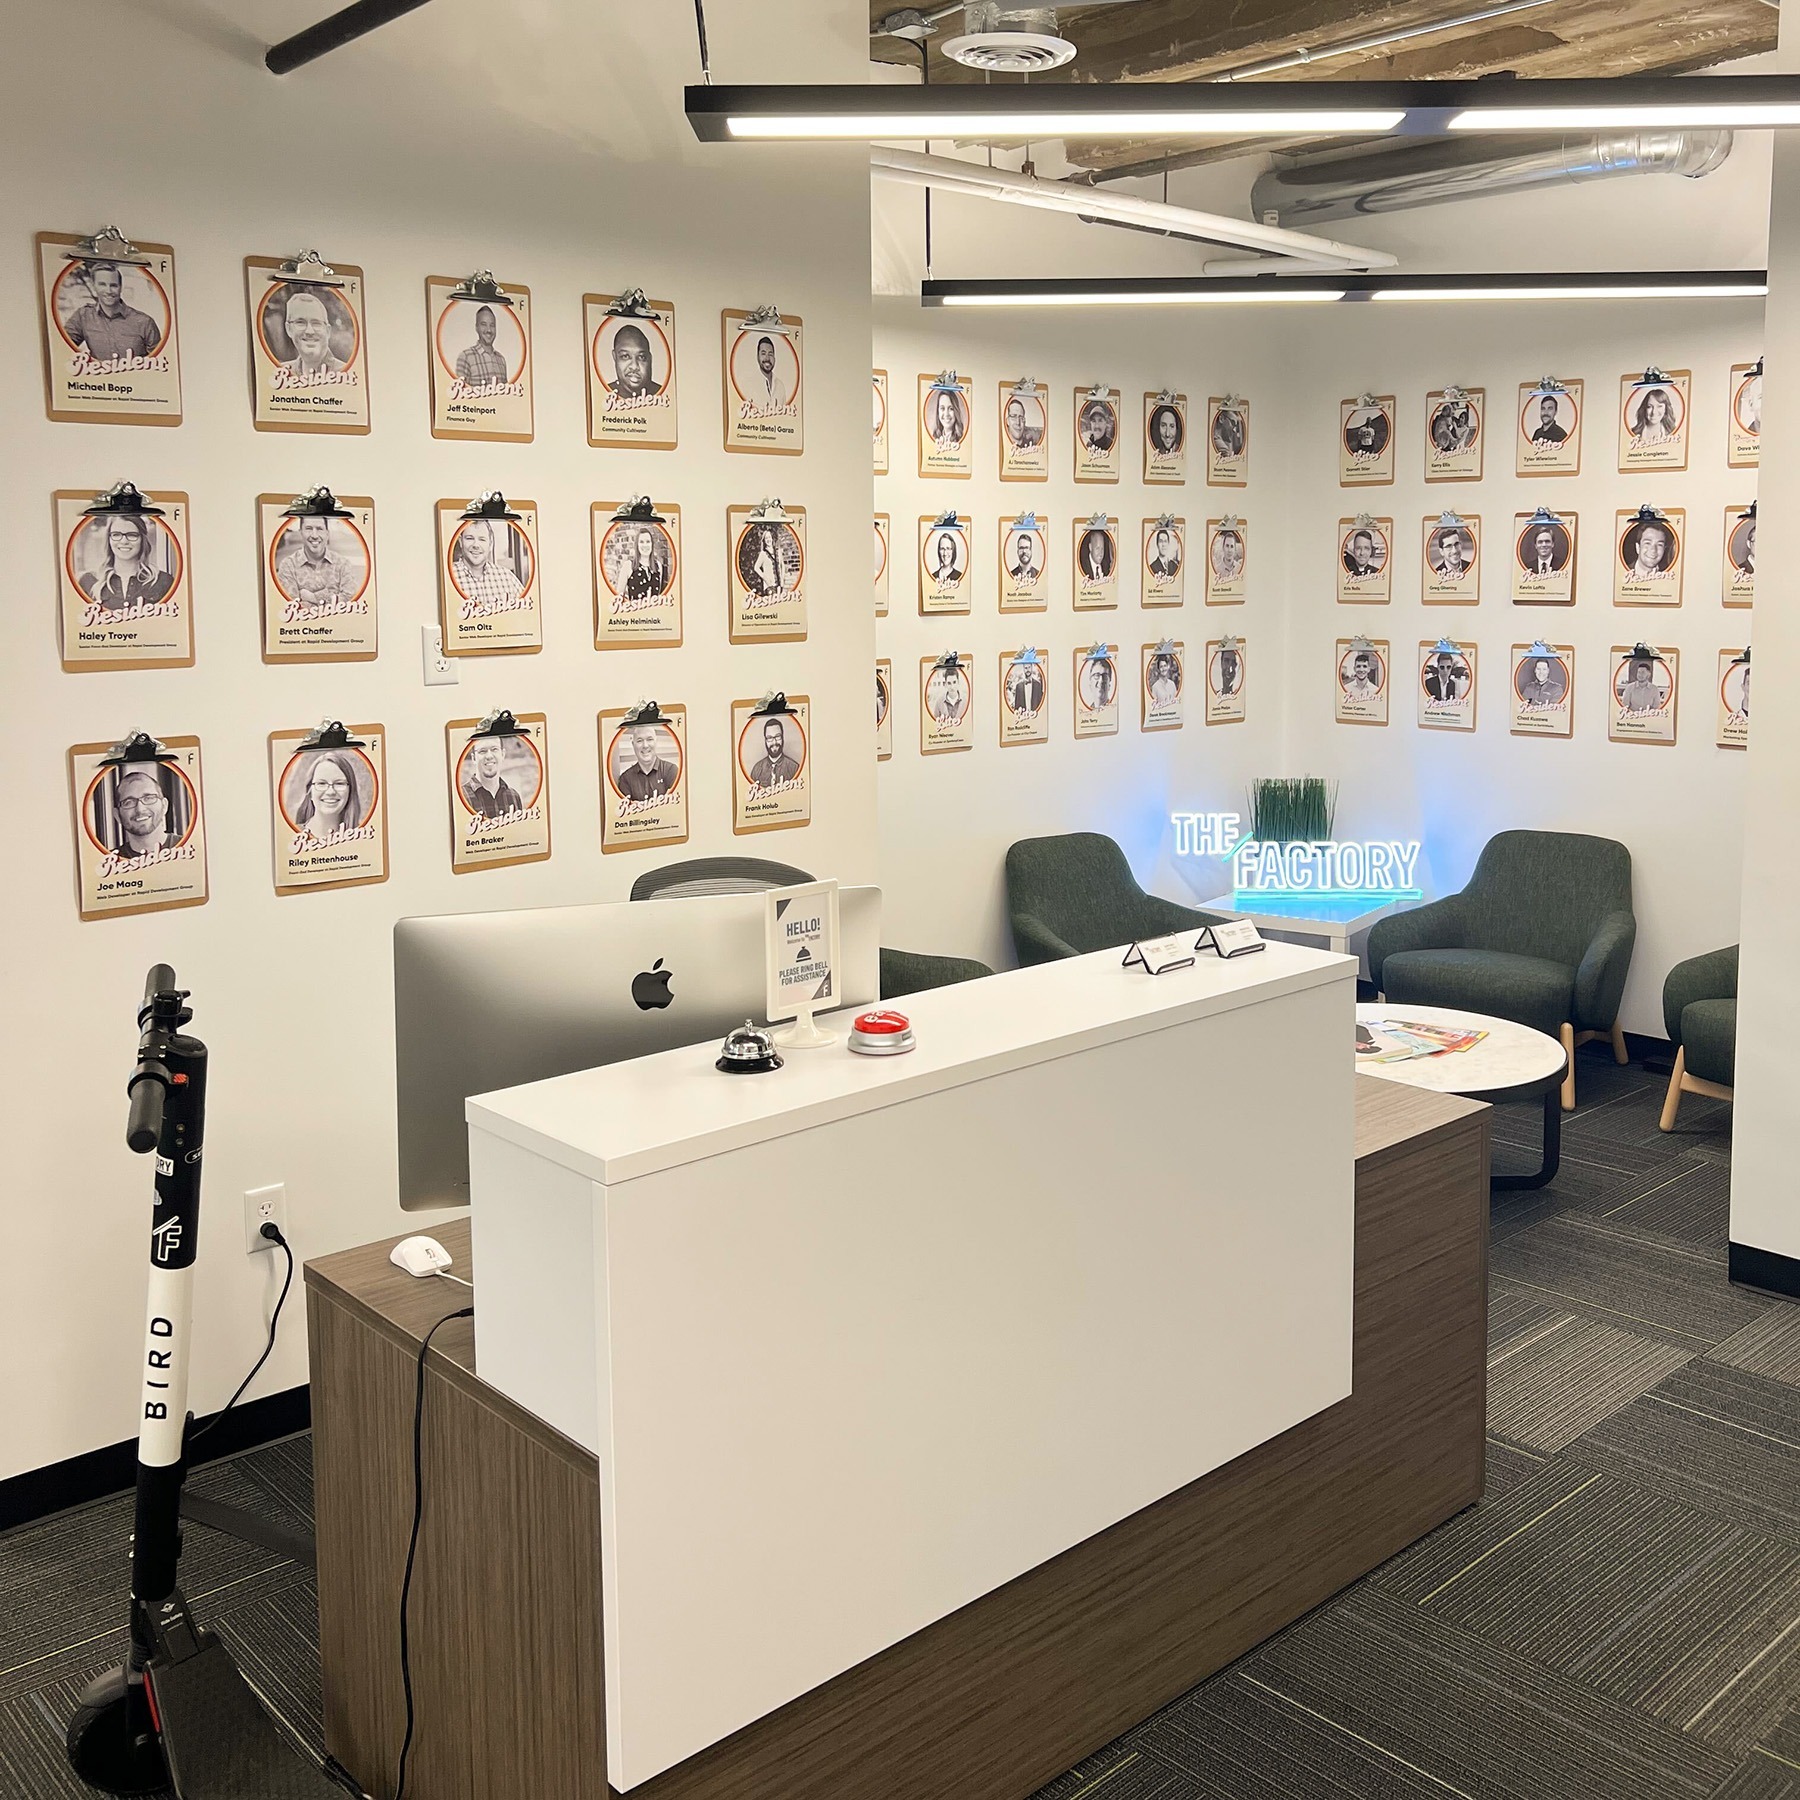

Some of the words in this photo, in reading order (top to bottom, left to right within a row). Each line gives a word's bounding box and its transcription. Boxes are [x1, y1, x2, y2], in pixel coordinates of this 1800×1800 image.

[69, 348, 169, 377] Resident
[270, 363, 358, 390] Resident
[67, 382, 106, 392] Michael
[107, 385, 133, 394] Bopp
[447, 376, 524, 400] Resident
[270, 395, 311, 405] Jonathan
[312, 396, 343, 405] Chaffer
[447, 404, 461, 412] Jeff
[462, 405, 496, 415] Steinport
[603, 388, 670, 412] Resident
[739, 399, 798, 420] Resident
[602, 416, 632, 425] Frederick
[633, 417, 648, 425] Polk
[737, 423, 759, 432] Alberto
[777, 426, 795, 434] Garza
[1629, 433, 1681, 450] Resident
[458, 592, 534, 620] Resident
[609, 588, 675, 614] Resident
[742, 585, 802, 610] Resident
[79, 596, 180, 627] Resident
[279, 594, 368, 623] Resident
[755, 612, 778, 620] Gilewski
[279, 627, 300, 635] Brett
[302, 627, 333, 635] Chaffer
[458, 625, 476, 633] Sam
[476, 623, 493, 632] Oltz
[608, 618, 629, 627] Ashley
[630, 617, 661, 625] Helminiak
[79, 632, 106, 641] Haley
[108, 632, 138, 641] Troyer
[747, 774, 804, 802] Resident
[616, 789, 681, 818] Resident
[745, 804, 760, 812] Frank
[762, 802, 779, 810] Holub
[465, 805, 541, 835] Resident
[614, 820, 628, 829] Dan
[629, 817, 661, 826] Billingsley
[288, 821, 376, 855] Resident
[466, 839, 480, 847] Ben
[481, 836, 504, 845] Braker
[1171, 812, 1241, 856] THE
[95, 841, 195, 878] Resident
[289, 859, 309, 868] Riley
[311, 854, 359, 864] Rittenhouse
[1233, 841, 1421, 890] FACTORY
[97, 883, 115, 892] Joe
[116, 880, 144, 889] Maag
[786, 917, 820, 937] HELLO!
[779, 966, 799, 979] PLEASE
[800, 963, 814, 973] RING
[815, 961, 828, 971] BELL
[781, 977, 794, 986] FOR
[794, 969, 827, 983] ASSISTANCE
[144, 1316, 173, 1420] BIRD
